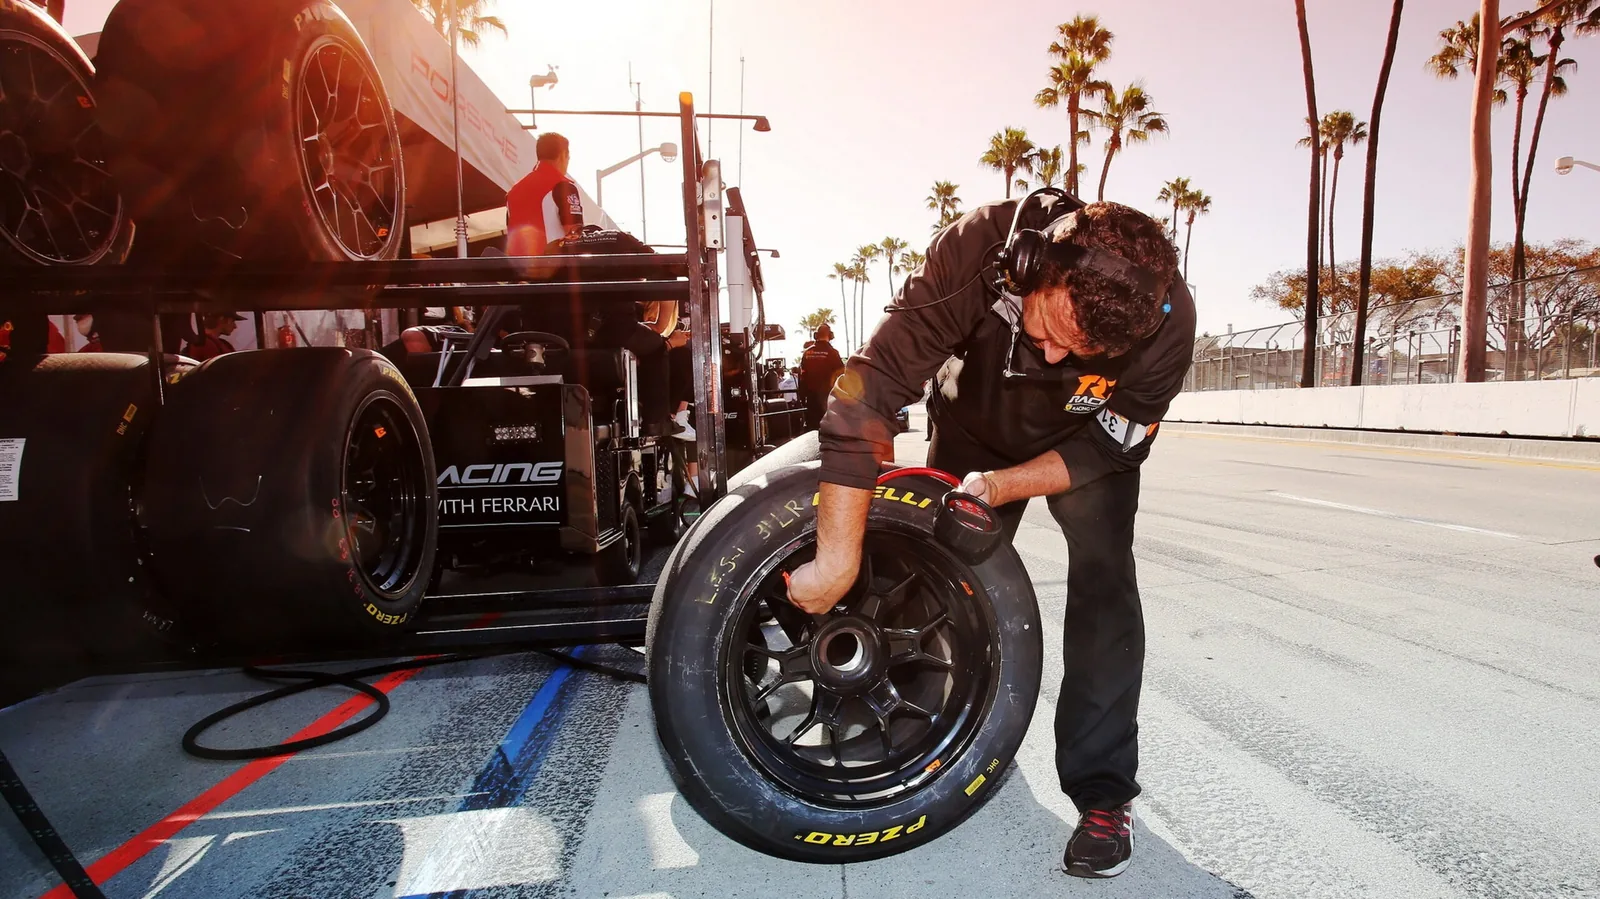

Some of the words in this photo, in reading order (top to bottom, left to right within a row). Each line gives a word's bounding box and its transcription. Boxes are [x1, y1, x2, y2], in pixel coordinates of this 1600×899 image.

[410, 51, 518, 164] PORSCHE
[437, 461, 564, 485] ACING
[482, 496, 560, 513] FERRARI
[366, 603, 408, 625] PZERO
[986, 758, 1000, 774] DHC
[804, 814, 927, 847] PZERO
